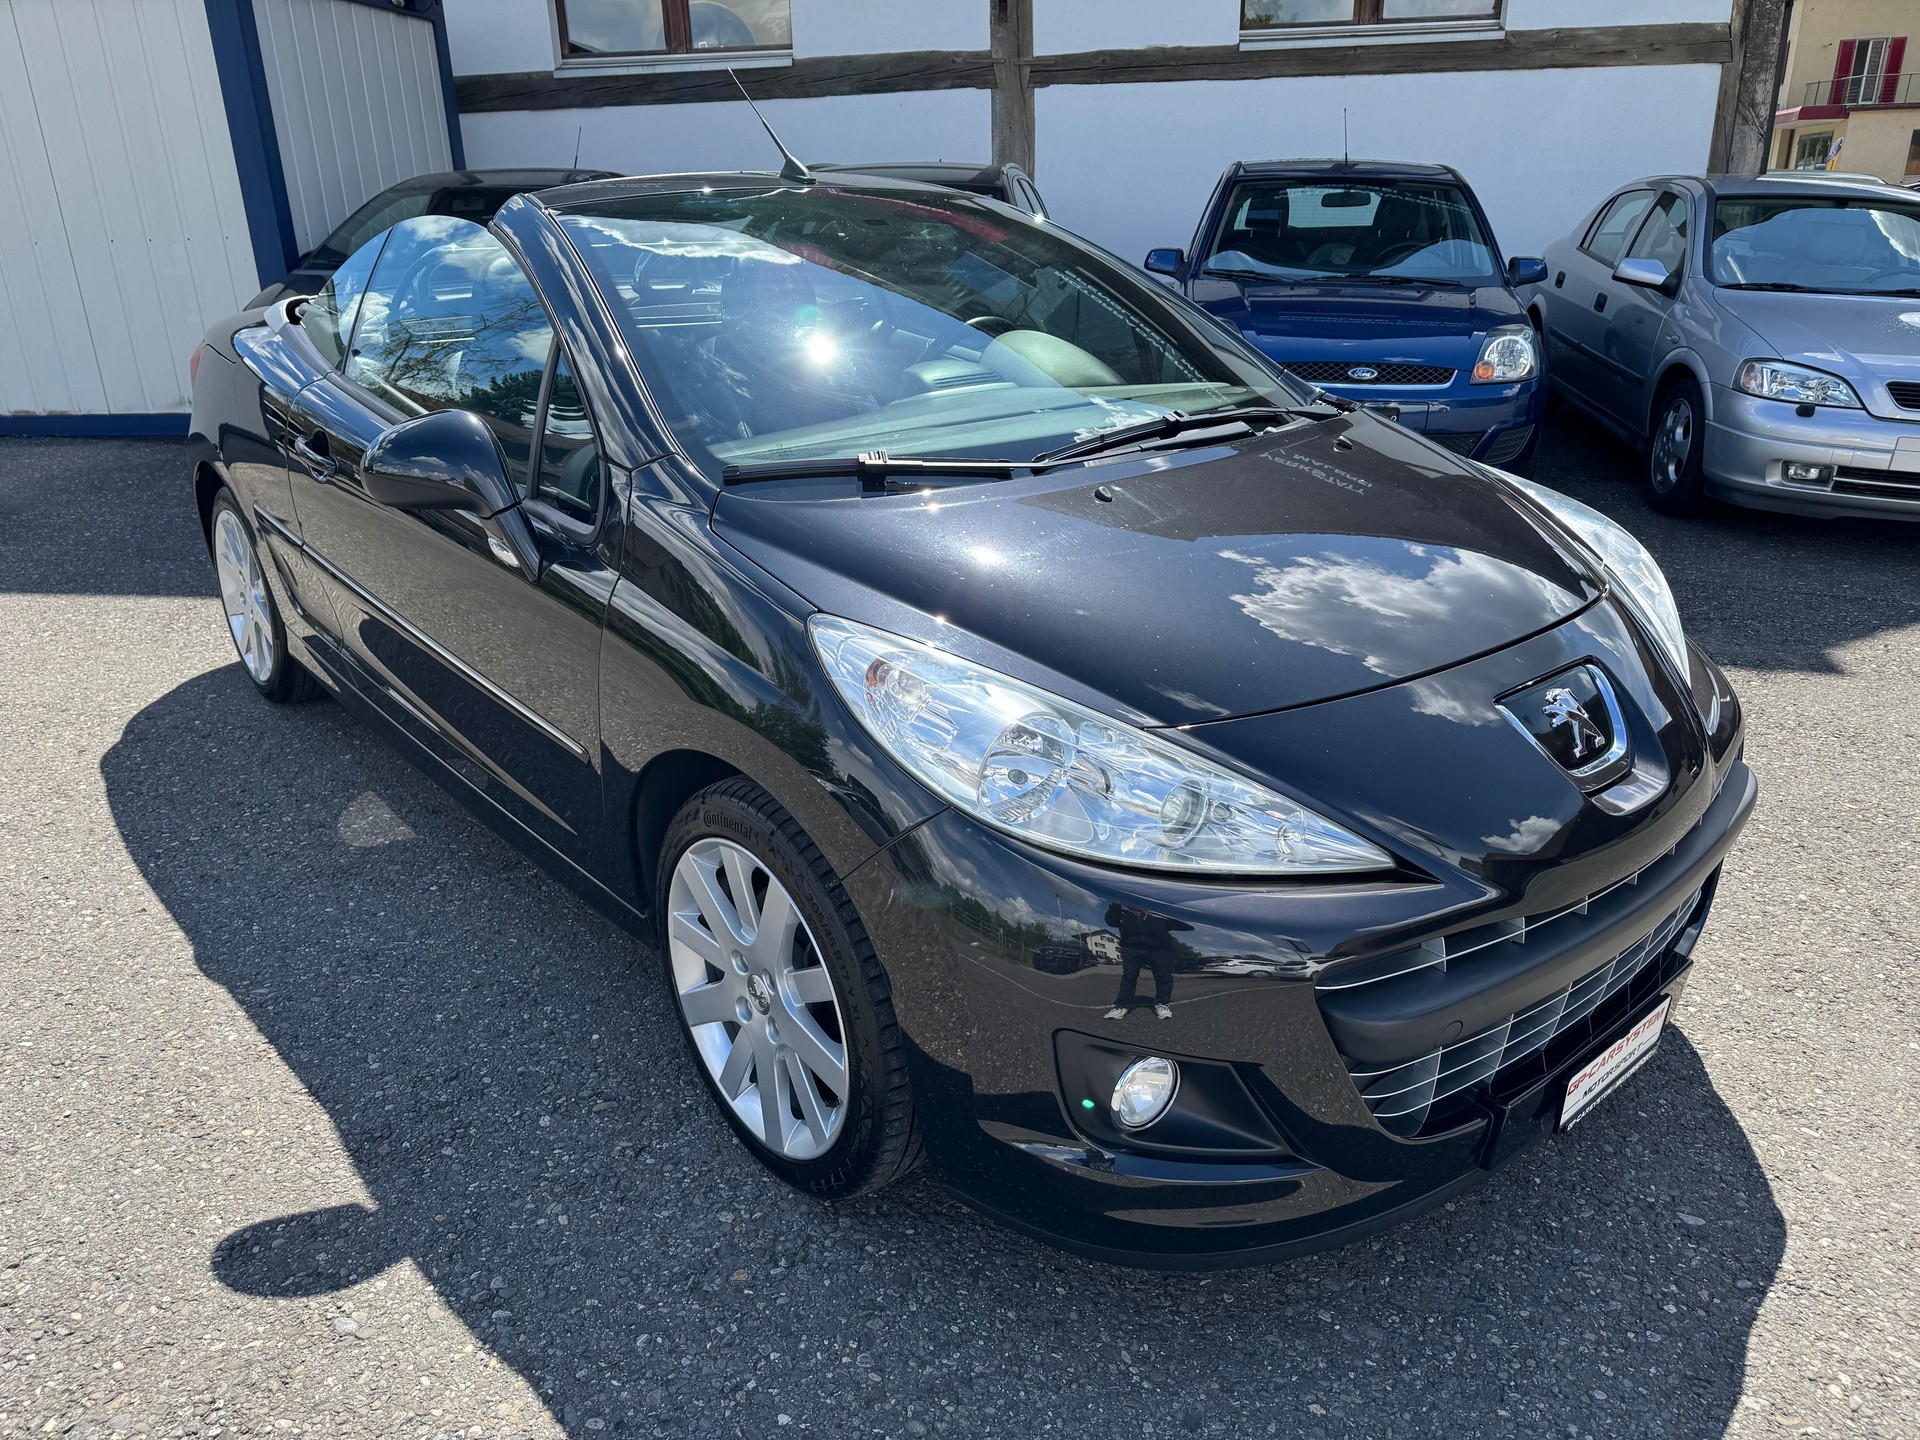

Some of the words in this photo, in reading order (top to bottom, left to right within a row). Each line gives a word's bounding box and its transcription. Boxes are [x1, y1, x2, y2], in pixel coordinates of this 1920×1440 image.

[703, 810, 752, 840] Continental
[1567, 1006, 1666, 1096] GP-CARSYSTEM
[1582, 1041, 1644, 1099] MOTORSPORT
